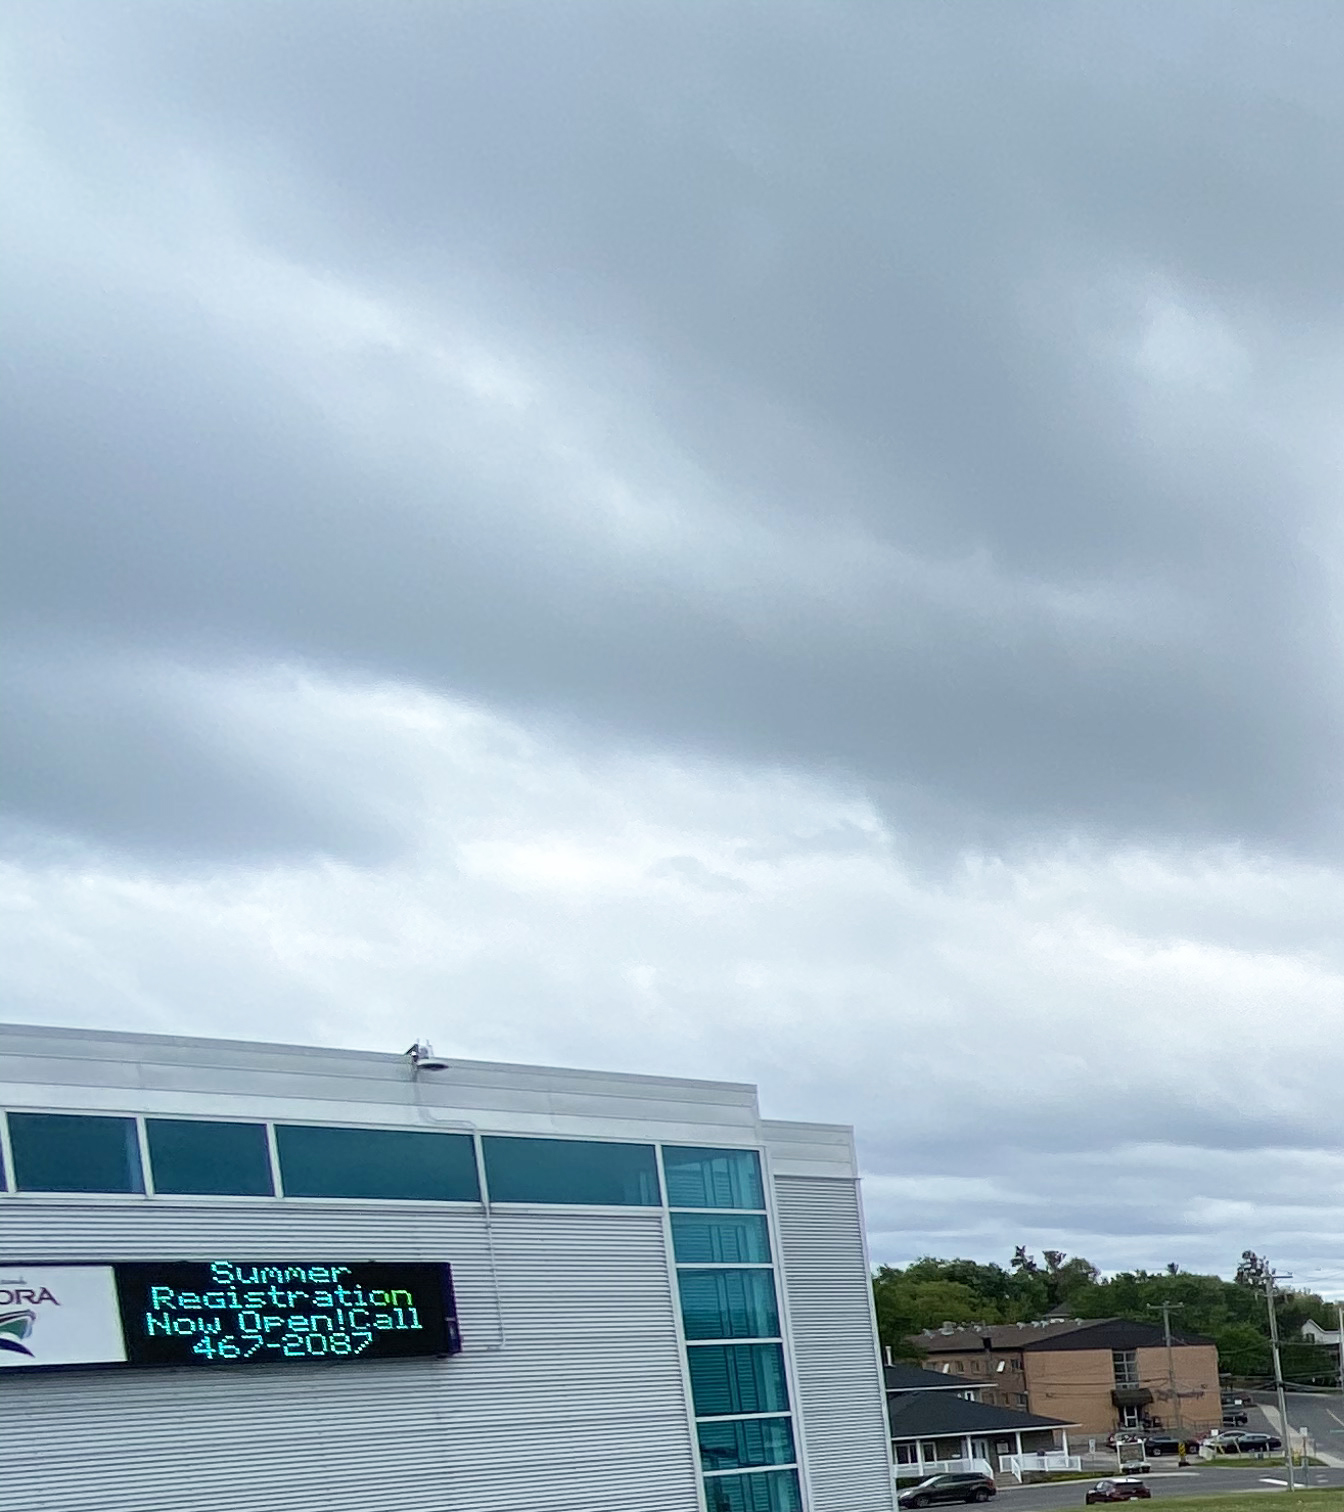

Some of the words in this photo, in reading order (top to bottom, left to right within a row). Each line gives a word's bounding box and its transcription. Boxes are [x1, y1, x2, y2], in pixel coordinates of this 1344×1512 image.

[211, 1260, 352, 1285] Summer
[151, 1285, 413, 1311] Registration
[145, 1312, 222, 1337] Now
[192, 1331, 374, 1360] 467-2087
